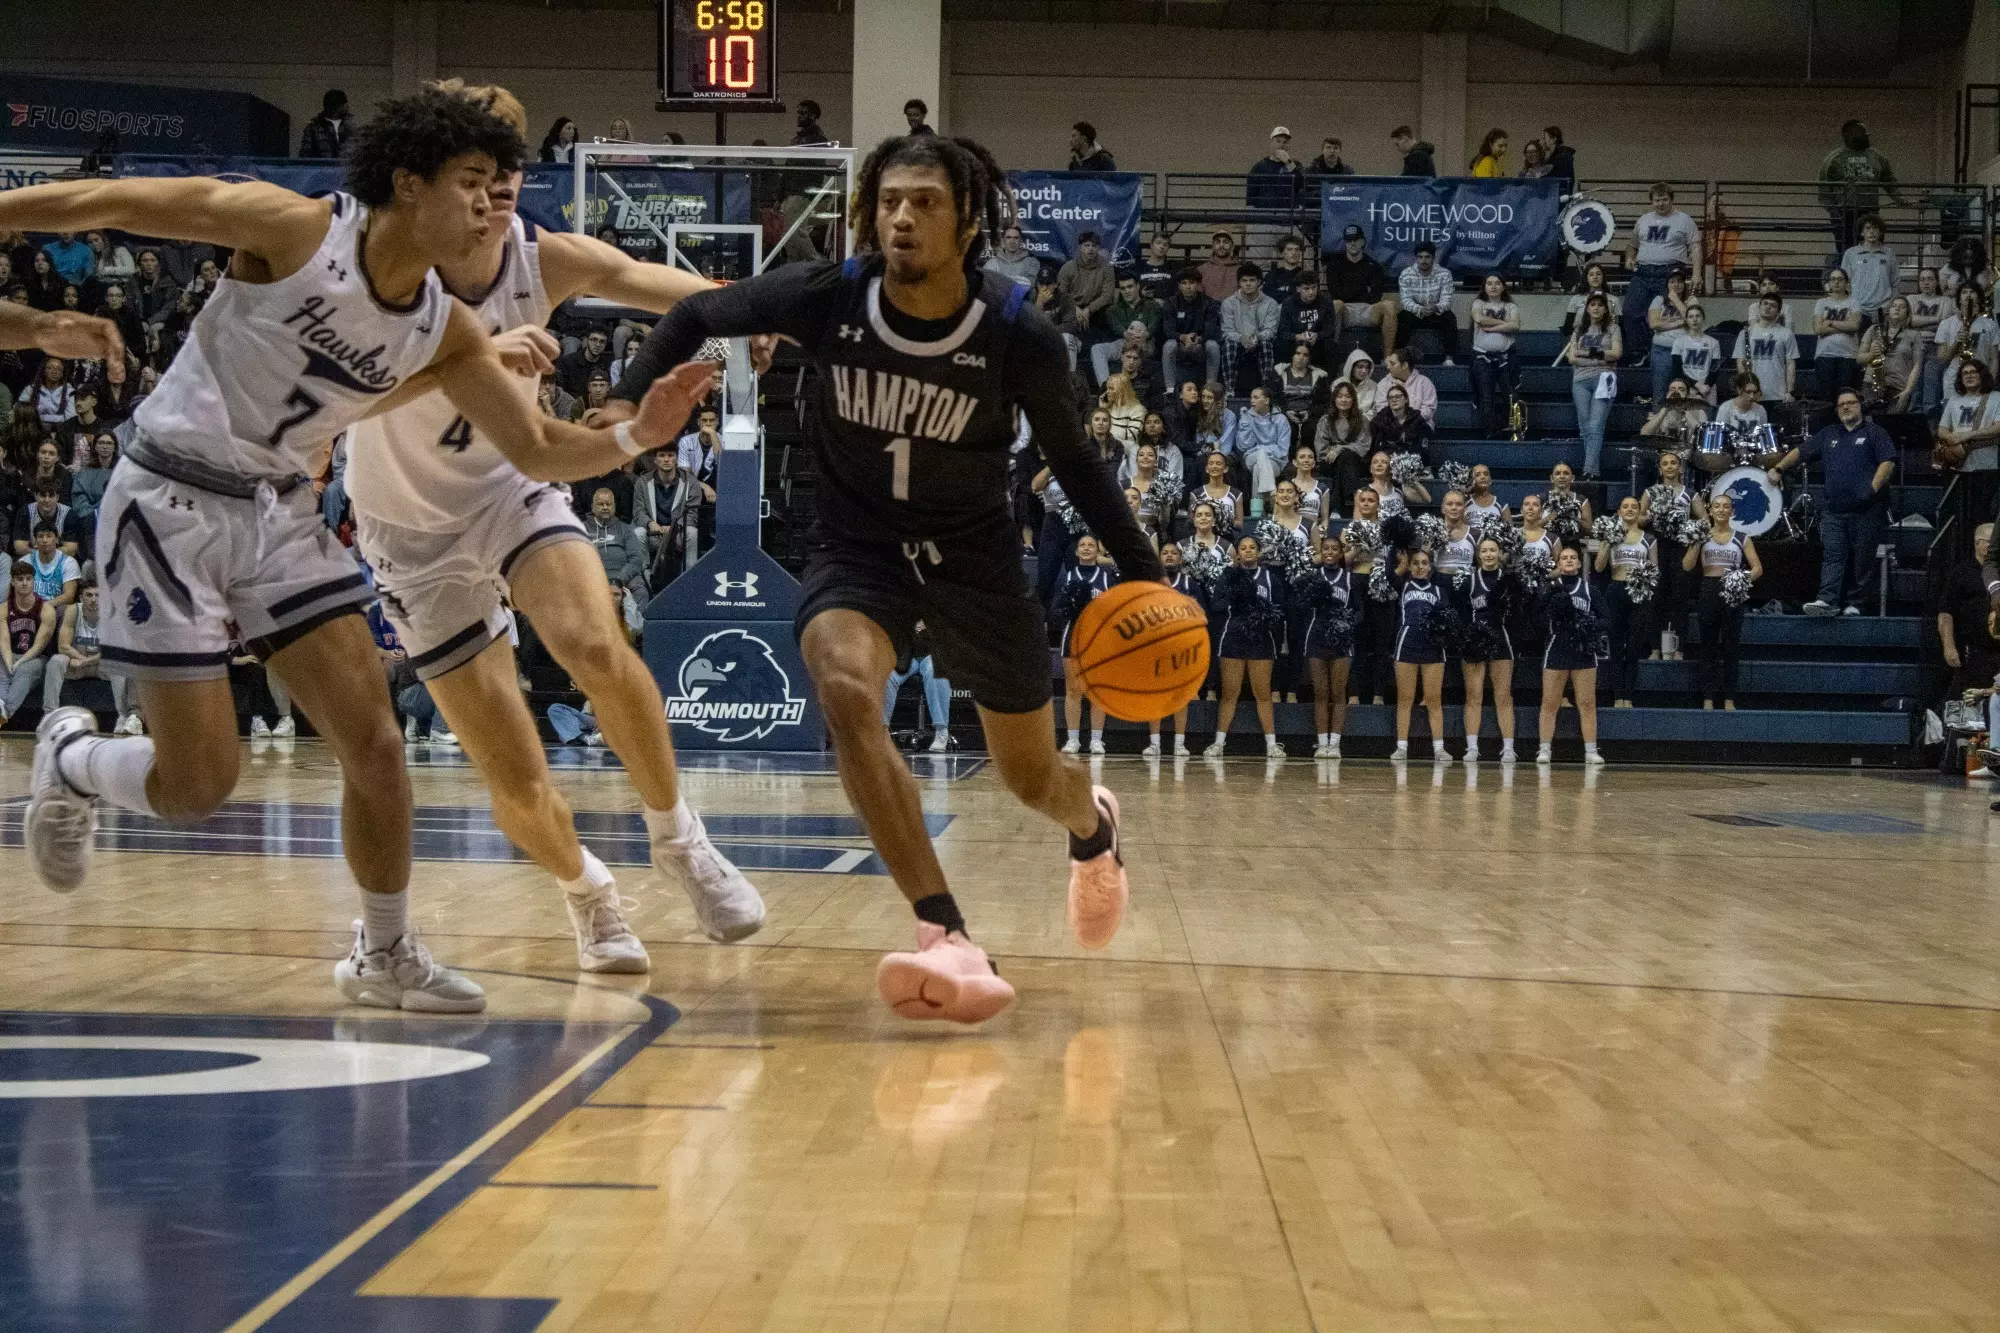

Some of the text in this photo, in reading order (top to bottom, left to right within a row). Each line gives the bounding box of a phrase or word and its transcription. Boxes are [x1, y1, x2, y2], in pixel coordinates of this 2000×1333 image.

[697, 1, 764, 30] 6:58
[709, 35, 754, 88] 10
[29, 105, 184, 138] FLOSPORTS
[630, 201, 703, 216] SUBARU
[1037, 203, 1102, 221] Center
[1367, 202, 1514, 225] HOMEWOOD
[1384, 226, 1496, 243] SUITES by Hilton
[1647, 225, 1671, 241] M
[283, 296, 398, 389] Hawks
[952, 352, 987, 370] CAA
[268, 384, 325, 447] 7
[831, 364, 979, 443] HAMPTON
[439, 413, 474, 453] 4
[884, 437, 911, 501] 1
[1114, 604, 1197, 640] Wilson
[668, 702, 800, 720] MONMOUTH
